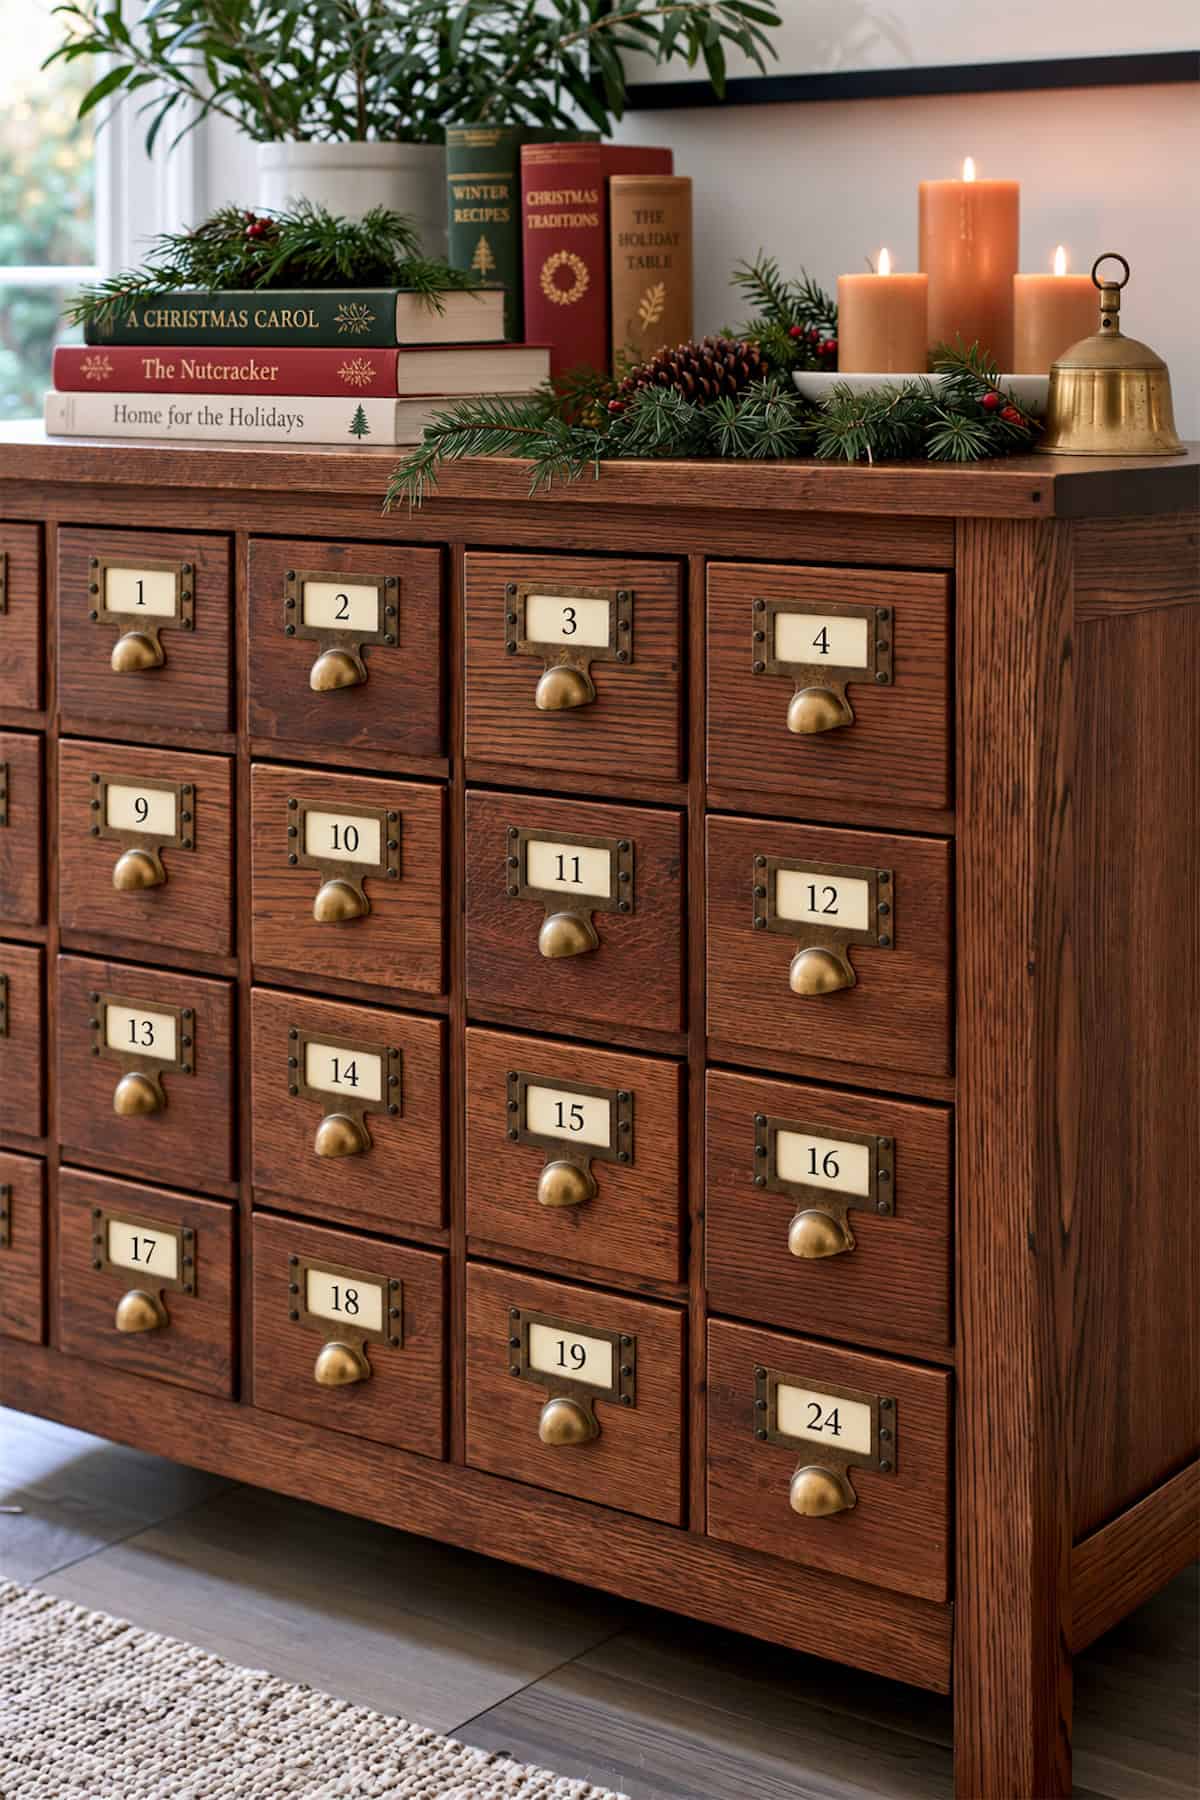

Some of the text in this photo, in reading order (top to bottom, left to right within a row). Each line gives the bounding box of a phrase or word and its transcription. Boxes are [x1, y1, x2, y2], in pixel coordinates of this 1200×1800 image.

[452, 184, 509, 200] WINTER
[526, 189, 598, 205] CHRISTMAS
[453, 207, 510, 223] RECIPES
[527, 213, 599, 229] TRADITIONS
[632, 209, 665, 225] THE
[618, 232, 680, 247] HOLIDAY
[625, 255, 673, 270] TABLE
[126, 309, 319, 329] A CHRISTMAS CAROL
[142, 358, 279, 381] The Nutcracker
[113, 404, 304, 433] Home for the Holidays
[135, 580, 146, 606] 1
[334, 593, 350, 621] 2
[561, 606, 577, 636] 3
[812, 626, 831, 655] 4
[134, 797, 149, 824] 9
[331, 823, 360, 853] 10
[555, 854, 583, 884] 11
[807, 884, 839, 915] 12
[129, 1019, 155, 1047] 13
[331, 1057, 360, 1087] 14
[554, 1101, 585, 1132] 15
[807, 1147, 840, 1179] 16
[131, 1236, 157, 1265] 17
[331, 1285, 360, 1316] 18
[556, 1340, 587, 1371] 19
[806, 1402, 843, 1437] 24
